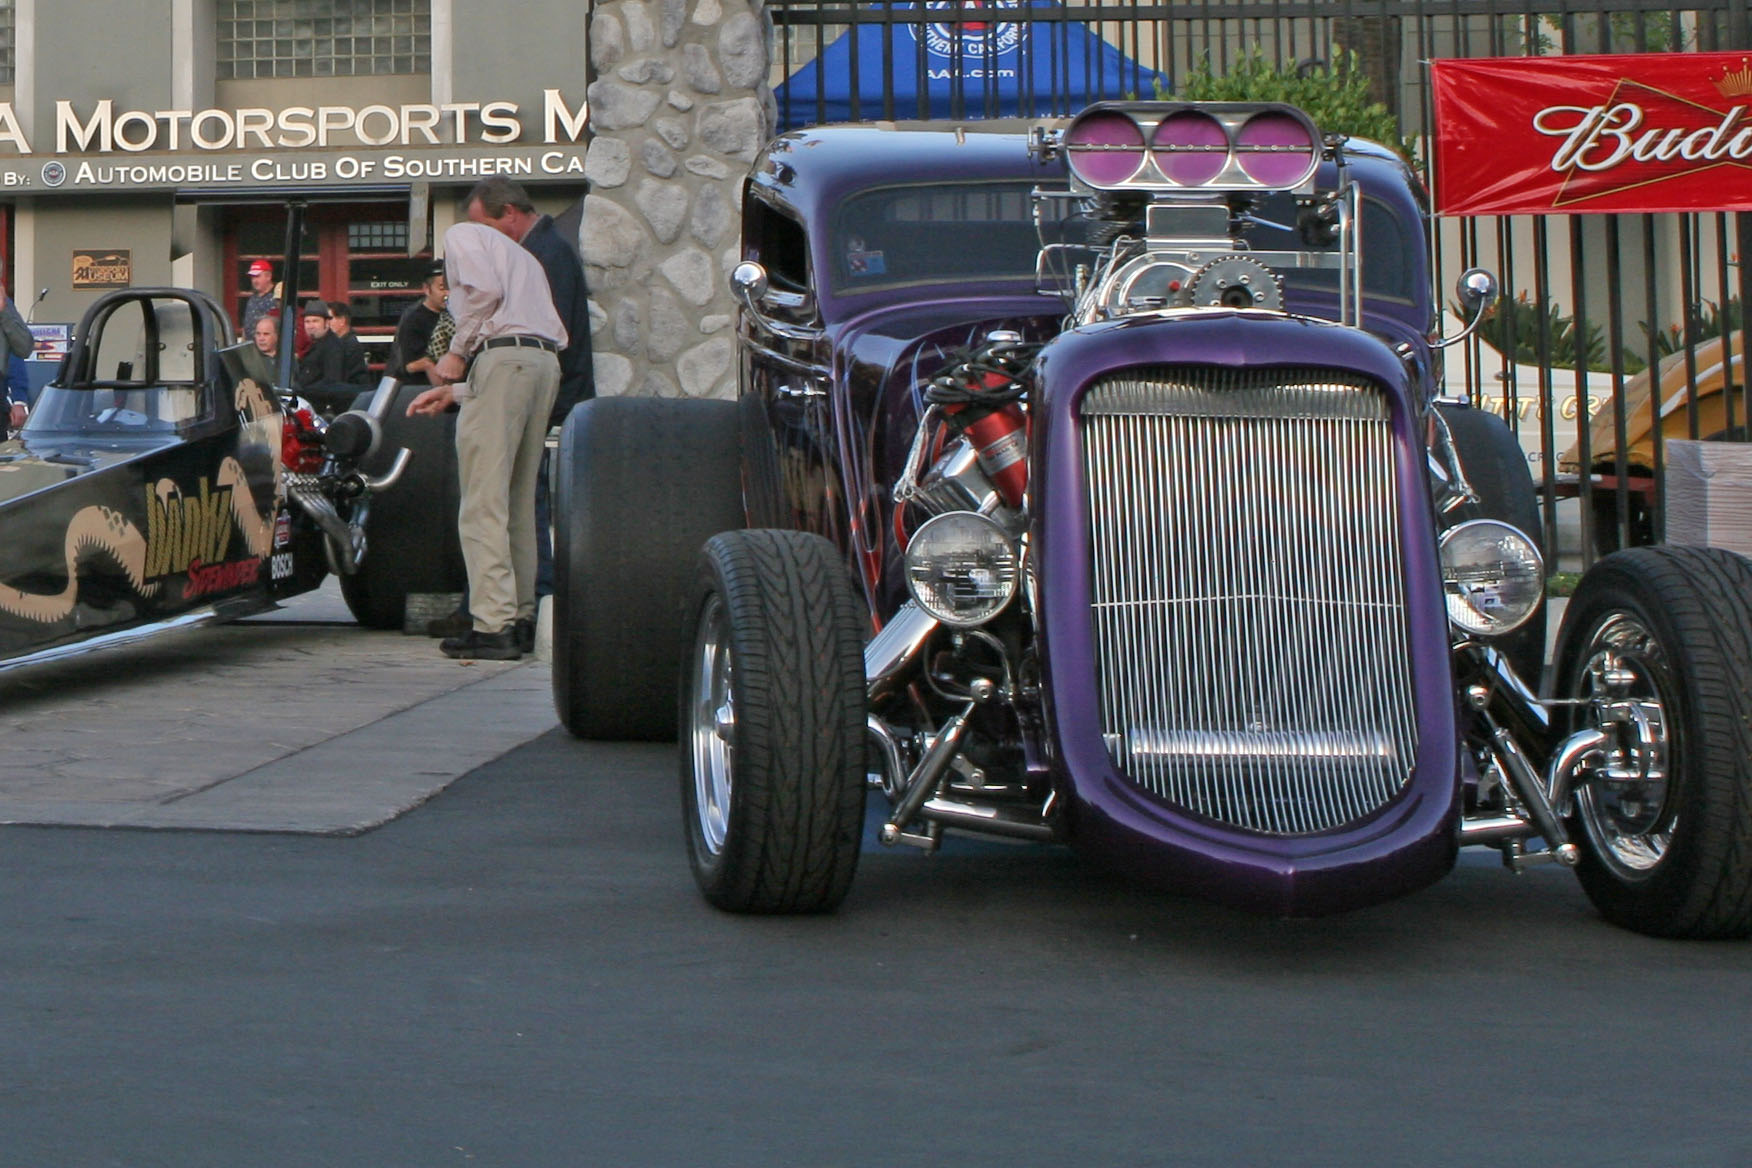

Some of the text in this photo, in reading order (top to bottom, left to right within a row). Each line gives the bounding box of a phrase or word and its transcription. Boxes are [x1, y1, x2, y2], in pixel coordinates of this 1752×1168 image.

[56, 99, 521, 153] MOTORSPORTS
[75, 162, 243, 184] AUTOMOBILE
[251, 159, 327, 181] CLUB
[335, 157, 376, 179] OF
[383, 153, 532, 178] SOUTHERN
[272, 552, 293, 579] BOSCH
